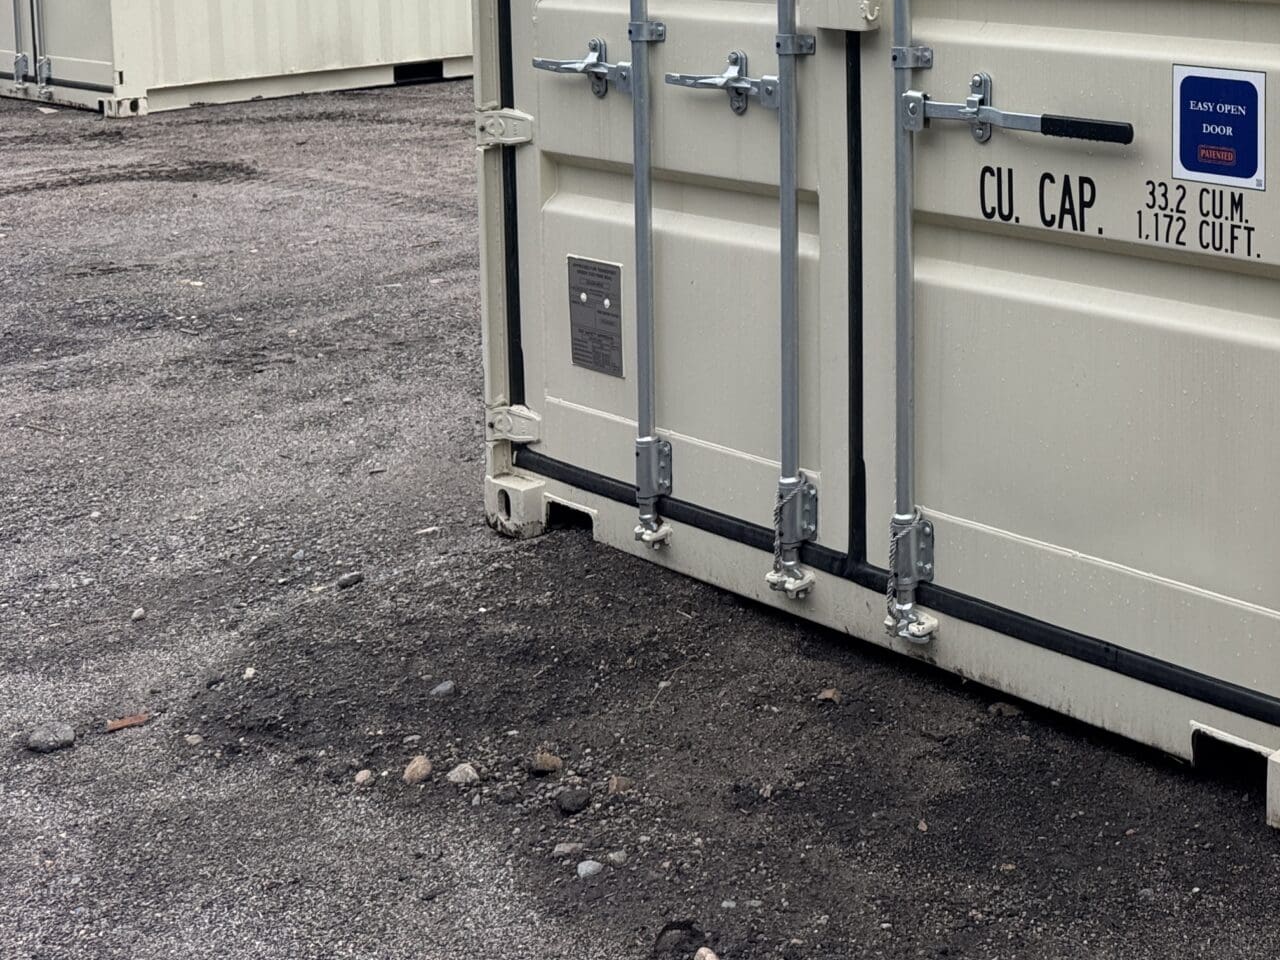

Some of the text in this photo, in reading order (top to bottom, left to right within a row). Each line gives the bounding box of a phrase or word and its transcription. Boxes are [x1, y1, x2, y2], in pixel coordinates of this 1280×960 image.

[1189, 100, 1247, 116] EASY OPEN
[1202, 123, 1233, 136] DOOR
[1200, 149, 1233, 161] PATENTED
[979, 165, 1249, 235] CU. CAP. 33.2 CU.M.
[1136, 210, 1261, 259] 1,172 CU.FT.
